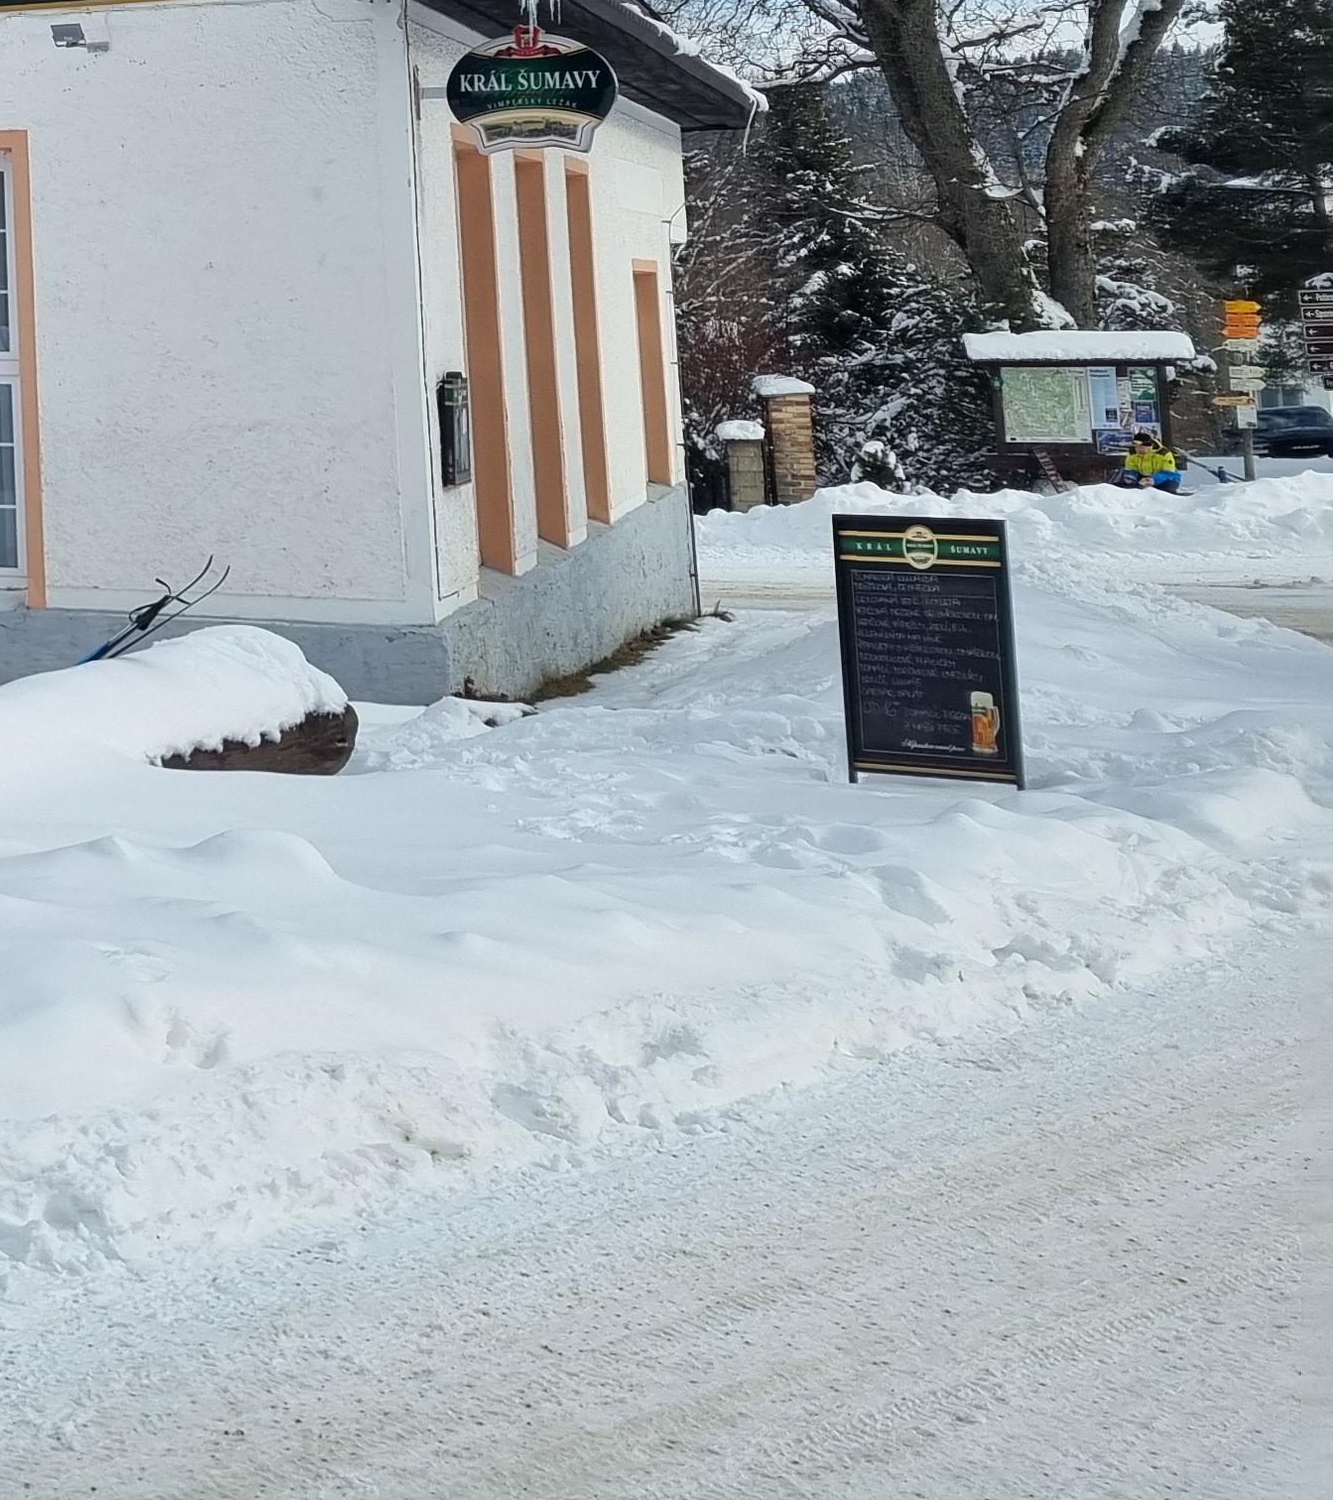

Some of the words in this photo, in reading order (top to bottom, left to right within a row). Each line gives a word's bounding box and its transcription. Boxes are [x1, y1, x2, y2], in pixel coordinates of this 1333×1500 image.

[459, 70, 512, 92] KRÁL
[517, 68, 601, 90] ŠUMAVY
[856, 541, 892, 551] KRÁL
[950, 544, 988, 555] ŠUMAVY
